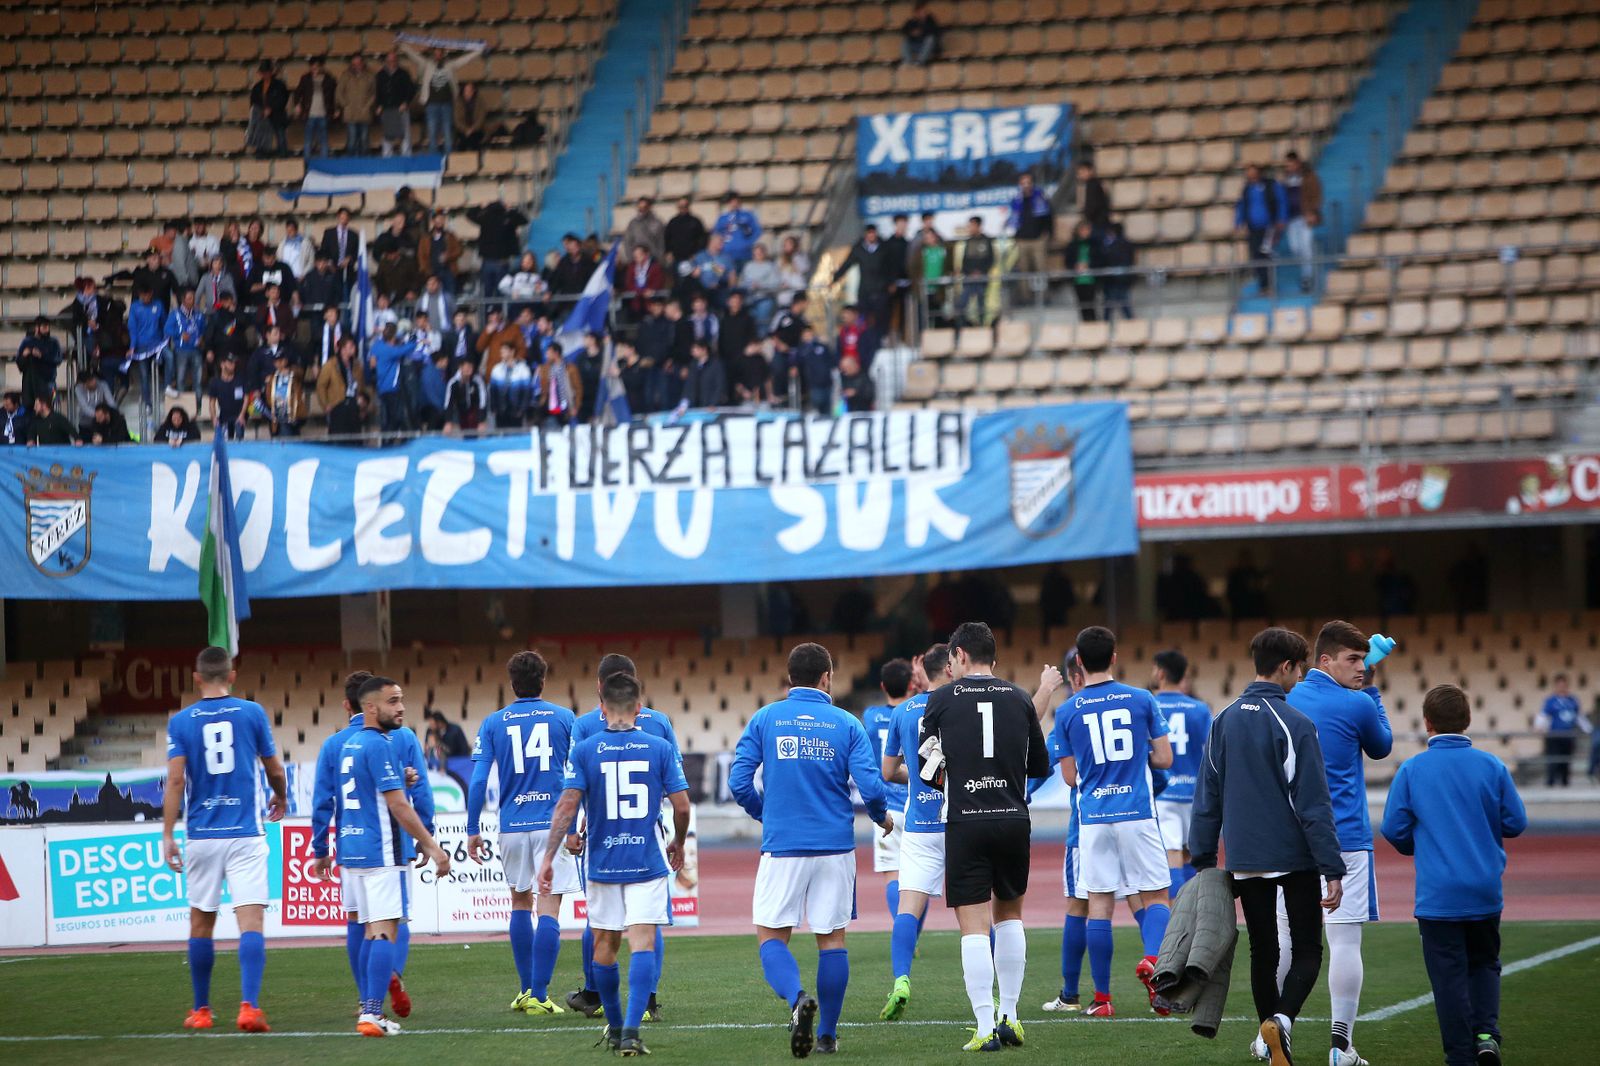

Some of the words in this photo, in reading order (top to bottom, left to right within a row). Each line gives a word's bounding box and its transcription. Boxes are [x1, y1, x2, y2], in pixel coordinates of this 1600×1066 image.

[867, 103, 1062, 166] XEREZ
[538, 415, 734, 489] FUERZA
[755, 411, 964, 483] CAZALLA
[1135, 477, 1301, 521] ruzcampo
[202, 720, 236, 776] 8
[506, 722, 553, 774] 14
[800, 736, 829, 747] Bellas
[800, 747, 835, 757] ARTES
[976, 701, 995, 759] 1
[1082, 708, 1134, 765] 16
[600, 760, 650, 820] 15
[917, 791, 944, 803] Beim
[75, 873, 187, 909] ESPECI
[288, 886, 315, 902] DEL
[55, 920, 101, 933] SEGUROS
[103, 918, 117, 928] DE
[118, 914, 157, 926] HOGAR
[452, 910, 470, 921] sin
